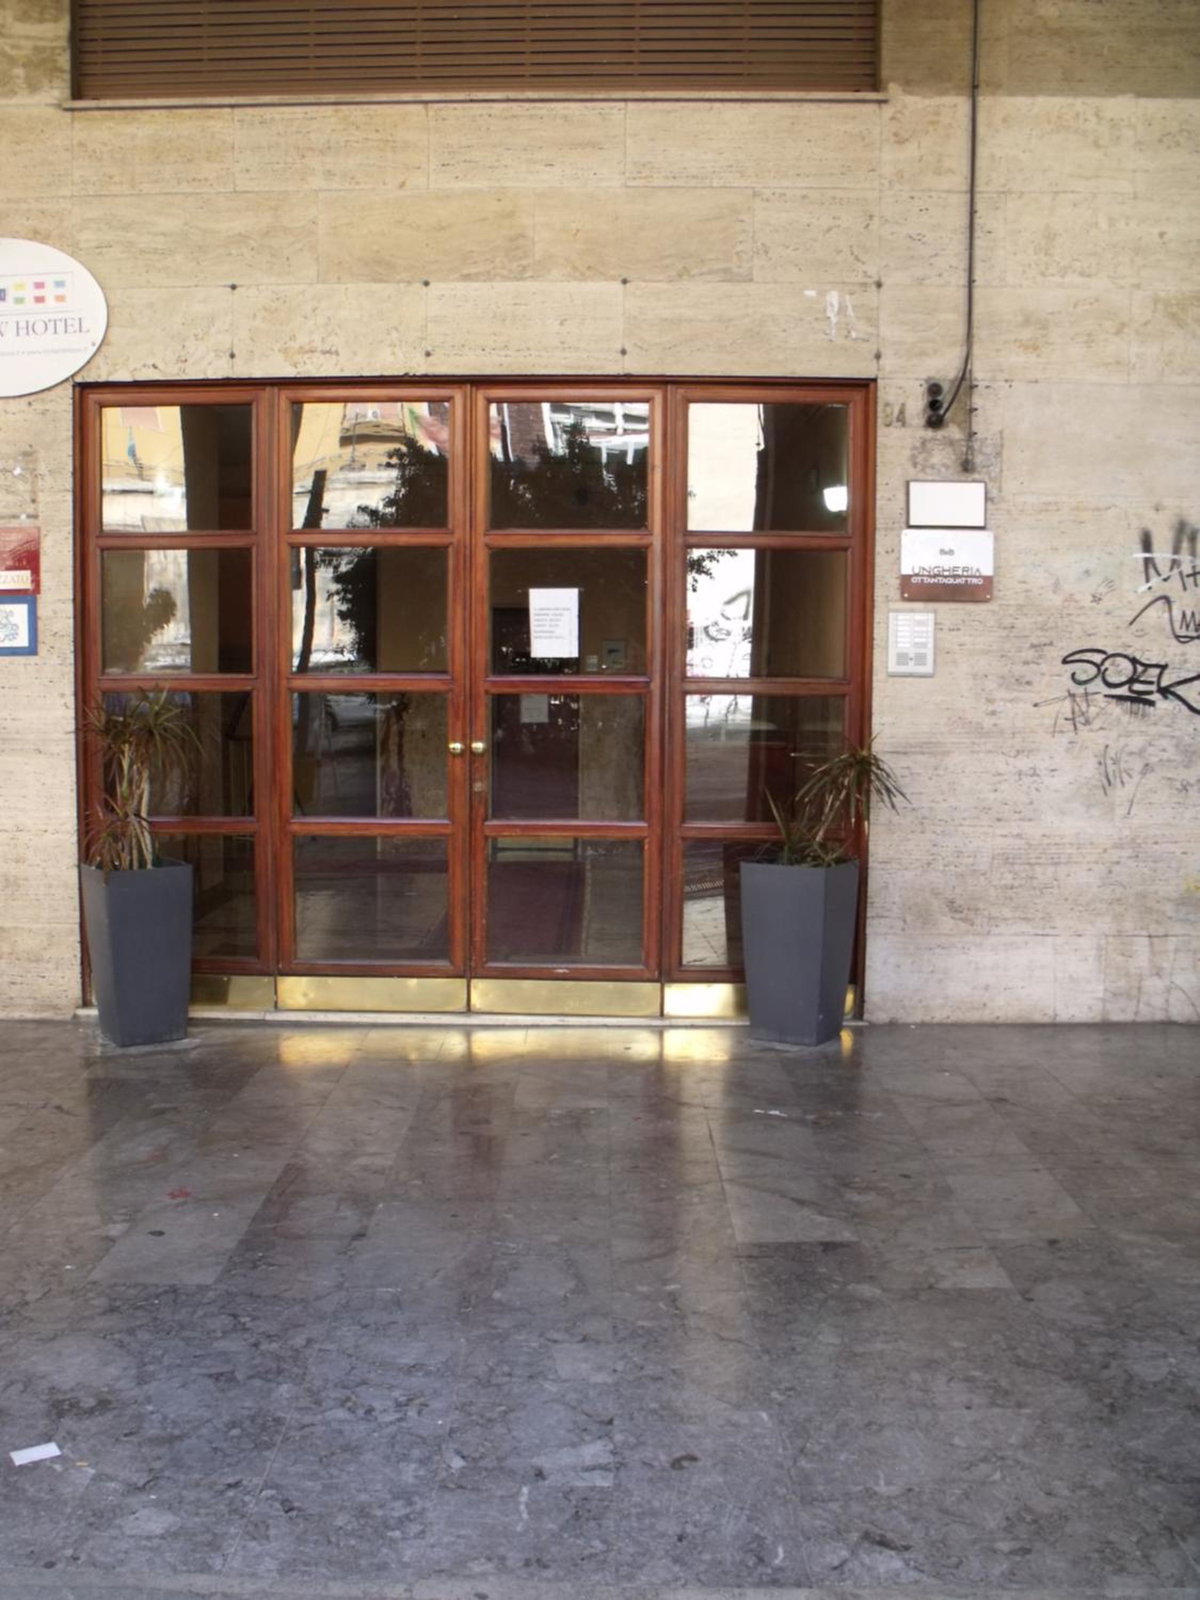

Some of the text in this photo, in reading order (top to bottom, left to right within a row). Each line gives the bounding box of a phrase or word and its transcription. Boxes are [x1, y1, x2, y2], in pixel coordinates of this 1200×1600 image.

[15, 316, 91, 337] HOTEL
[911, 565, 982, 578] UNGHERIA
[910, 576, 984, 585] OTTANTAQUATTRO
